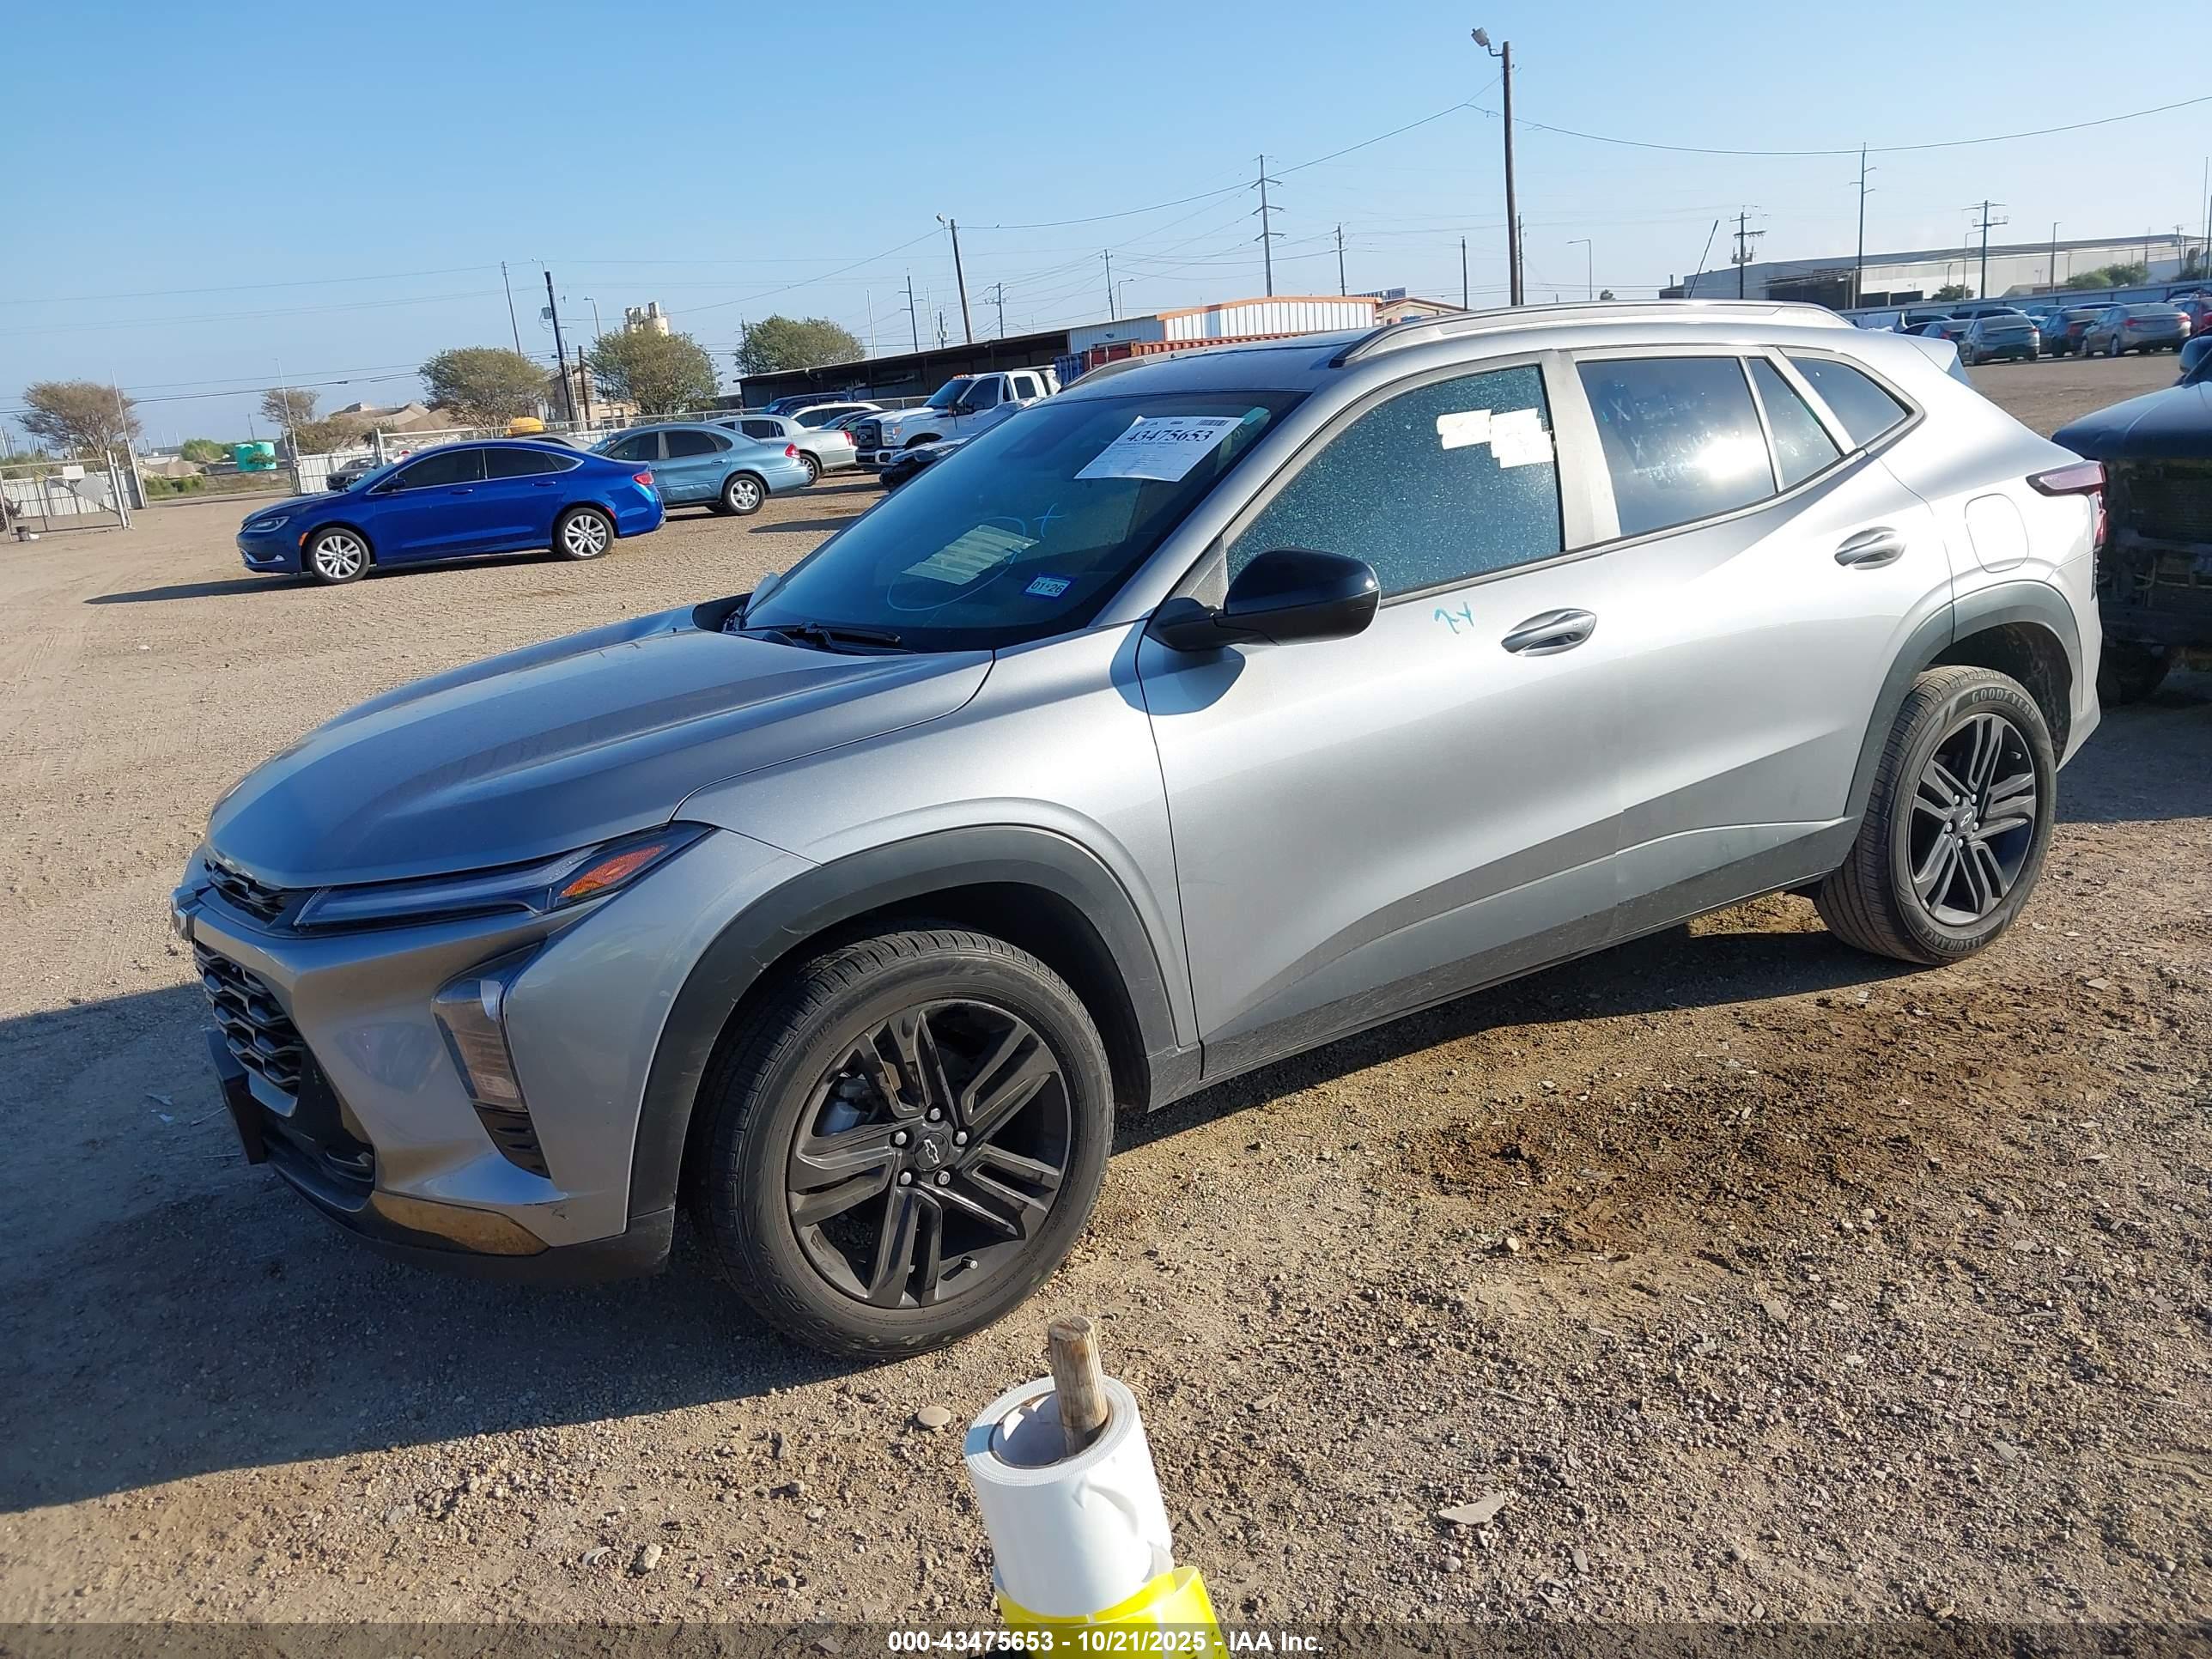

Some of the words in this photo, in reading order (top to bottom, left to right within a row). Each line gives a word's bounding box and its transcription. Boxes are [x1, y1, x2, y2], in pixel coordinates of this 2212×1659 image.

[1127, 429, 1214, 442] 43475653
[1971, 687, 2037, 722] GOODYEAR
[1919, 926, 1986, 951] ASSURANCE
